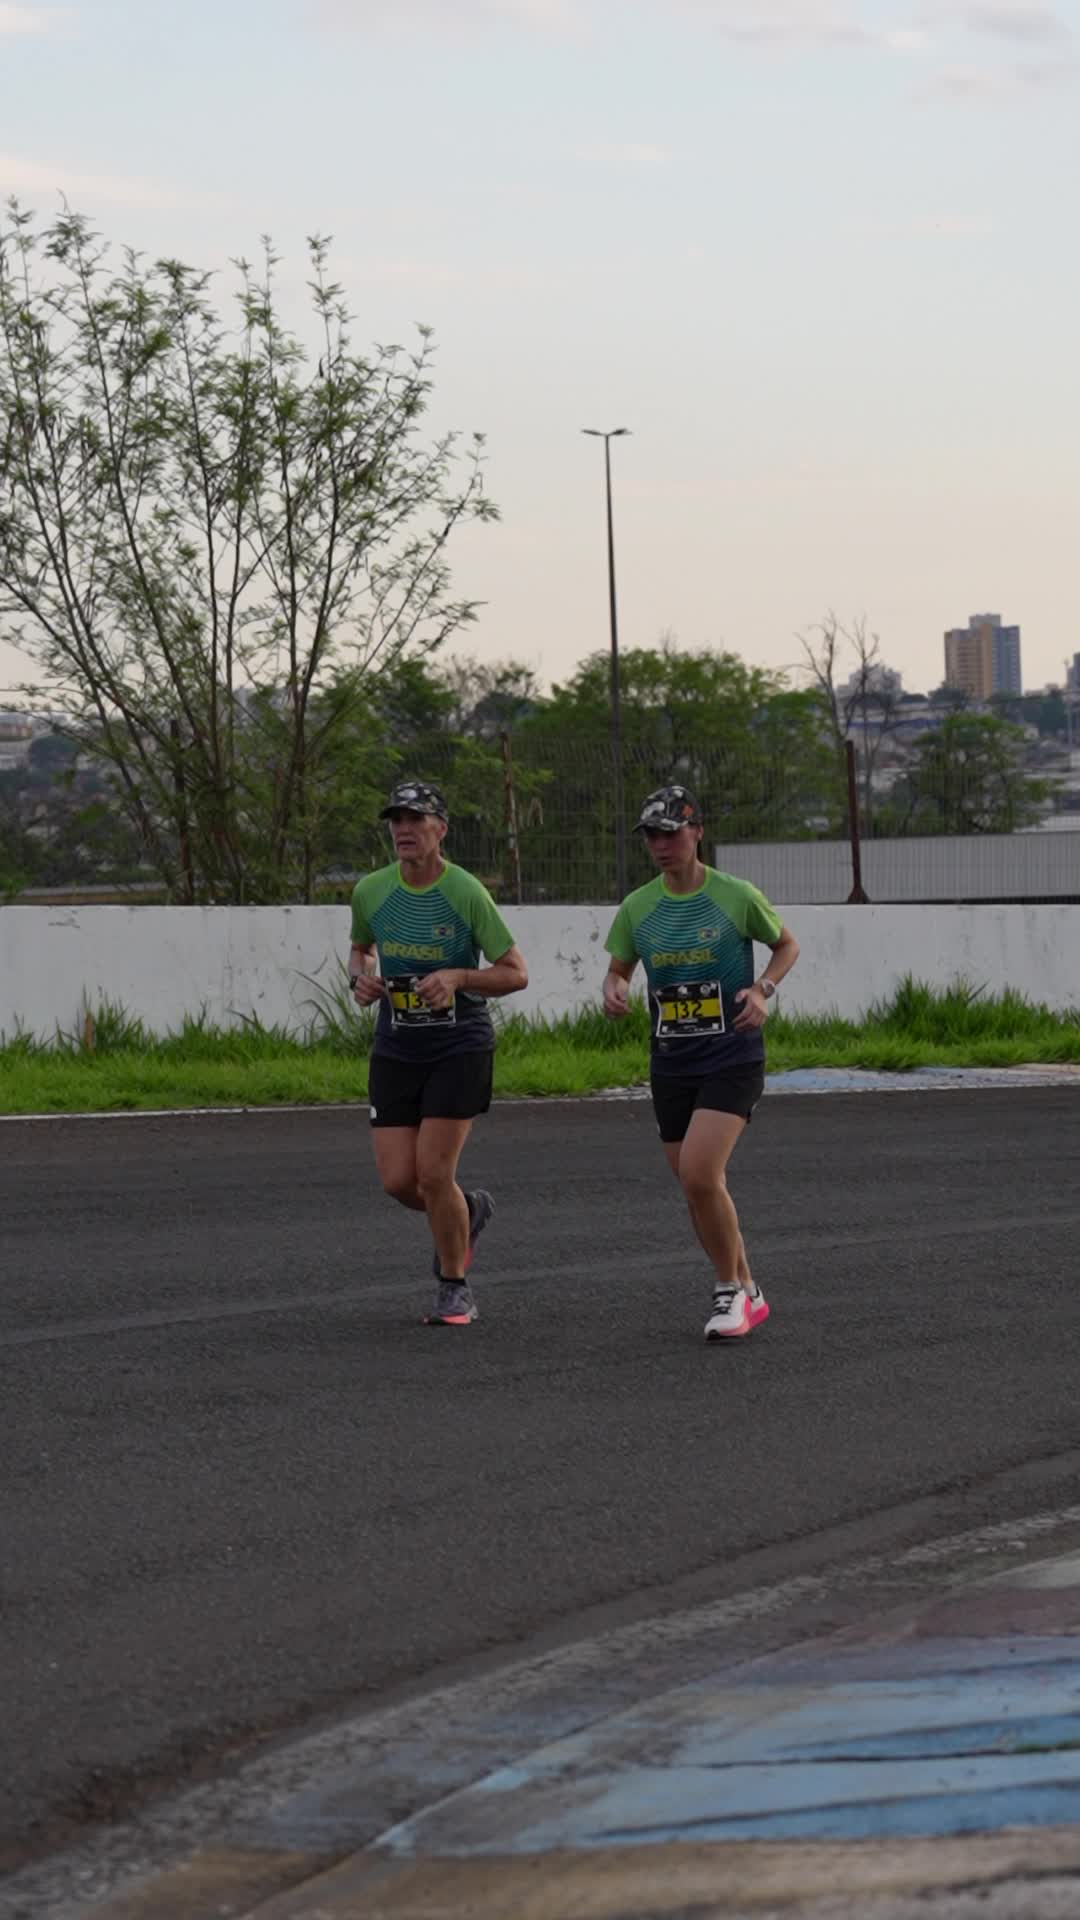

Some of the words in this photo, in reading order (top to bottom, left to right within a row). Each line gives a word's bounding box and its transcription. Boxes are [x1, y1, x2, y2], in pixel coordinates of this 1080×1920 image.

[383, 942, 446, 960] BRASIL
[652, 949, 715, 968] BRASIL
[402, 992, 431, 1009] 13
[673, 1000, 703, 1019] 132
